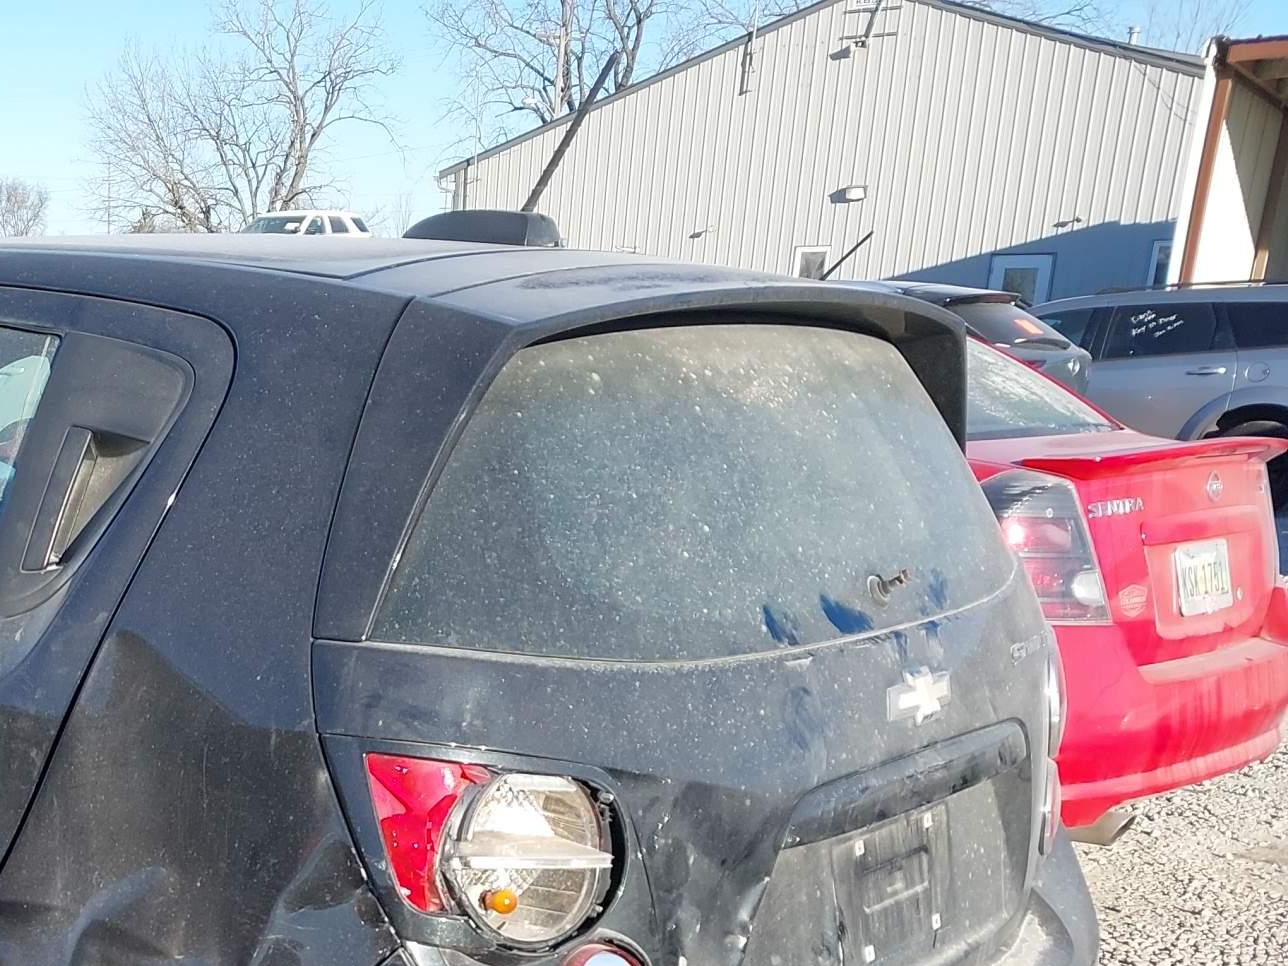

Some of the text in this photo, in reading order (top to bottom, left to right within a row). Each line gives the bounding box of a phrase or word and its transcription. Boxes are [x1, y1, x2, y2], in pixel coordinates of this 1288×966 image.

[1087, 497, 1145, 519] SENTRA
[1180, 561, 1226, 598] KSK 1751
